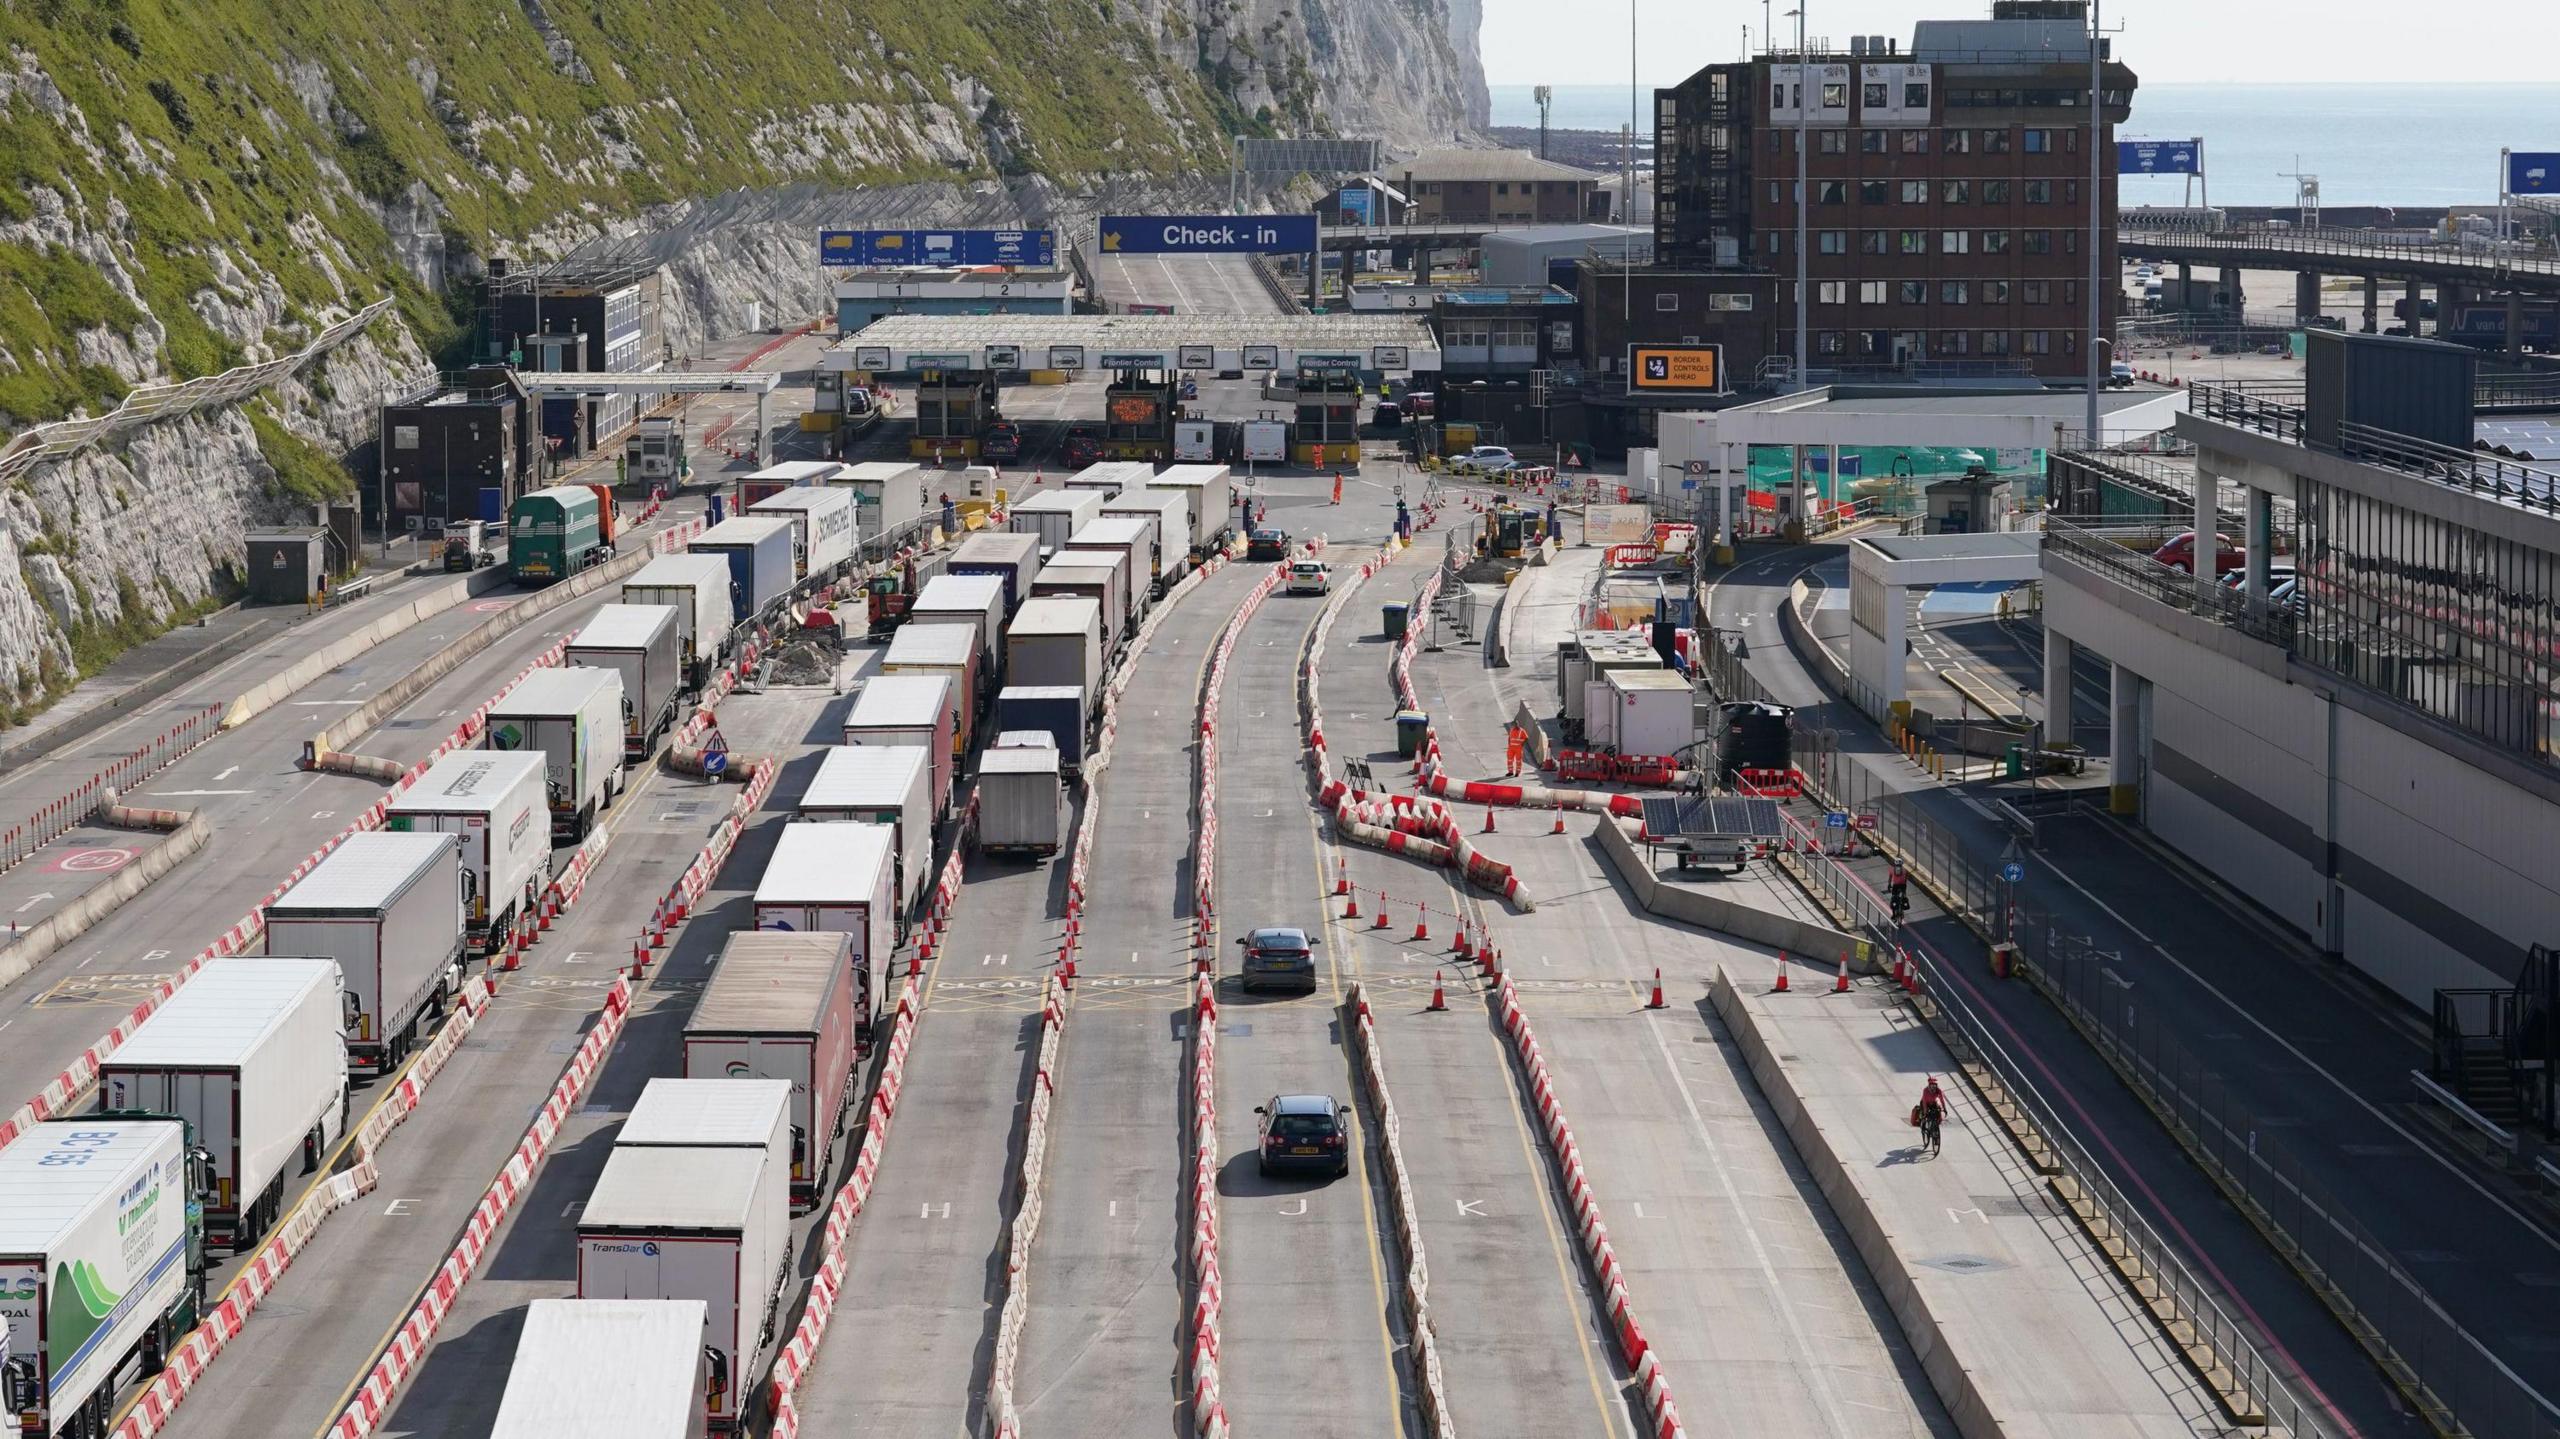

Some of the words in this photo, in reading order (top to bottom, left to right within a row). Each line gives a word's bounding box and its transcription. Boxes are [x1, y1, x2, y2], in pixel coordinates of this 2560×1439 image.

[1163, 225, 1235, 245] Check
[1257, 225, 1277, 244] in
[823, 256, 843, 264] Check
[872, 256, 893, 264] Check
[896, 285, 902, 296] 1
[1001, 285, 1009, 296] 2
[1408, 295, 1416, 307] 3
[2475, 320, 2496, 331] van
[911, 359, 938, 367] Frontier
[1103, 359, 1133, 368] Frontier
[1133, 358, 1160, 367] Control
[1300, 359, 1330, 367] Frontier
[1330, 358, 1360, 367] Control
[142, 949, 172, 961] B
[564, 951, 593, 964] E
[983, 953, 1008, 966] H
[1402, 951, 1426, 963] K
[937, 980, 1041, 989] CLEAR
[60, 1132, 119, 1147] BC
[384, 1198, 423, 1217] E
[921, 1201, 951, 1219] H
[1278, 1199, 1307, 1216] J
[1455, 1199, 1489, 1217] K
[1633, 1201, 1668, 1219] L
[1945, 1207, 1990, 1225] M
[591, 1242, 642, 1254] TransDar
